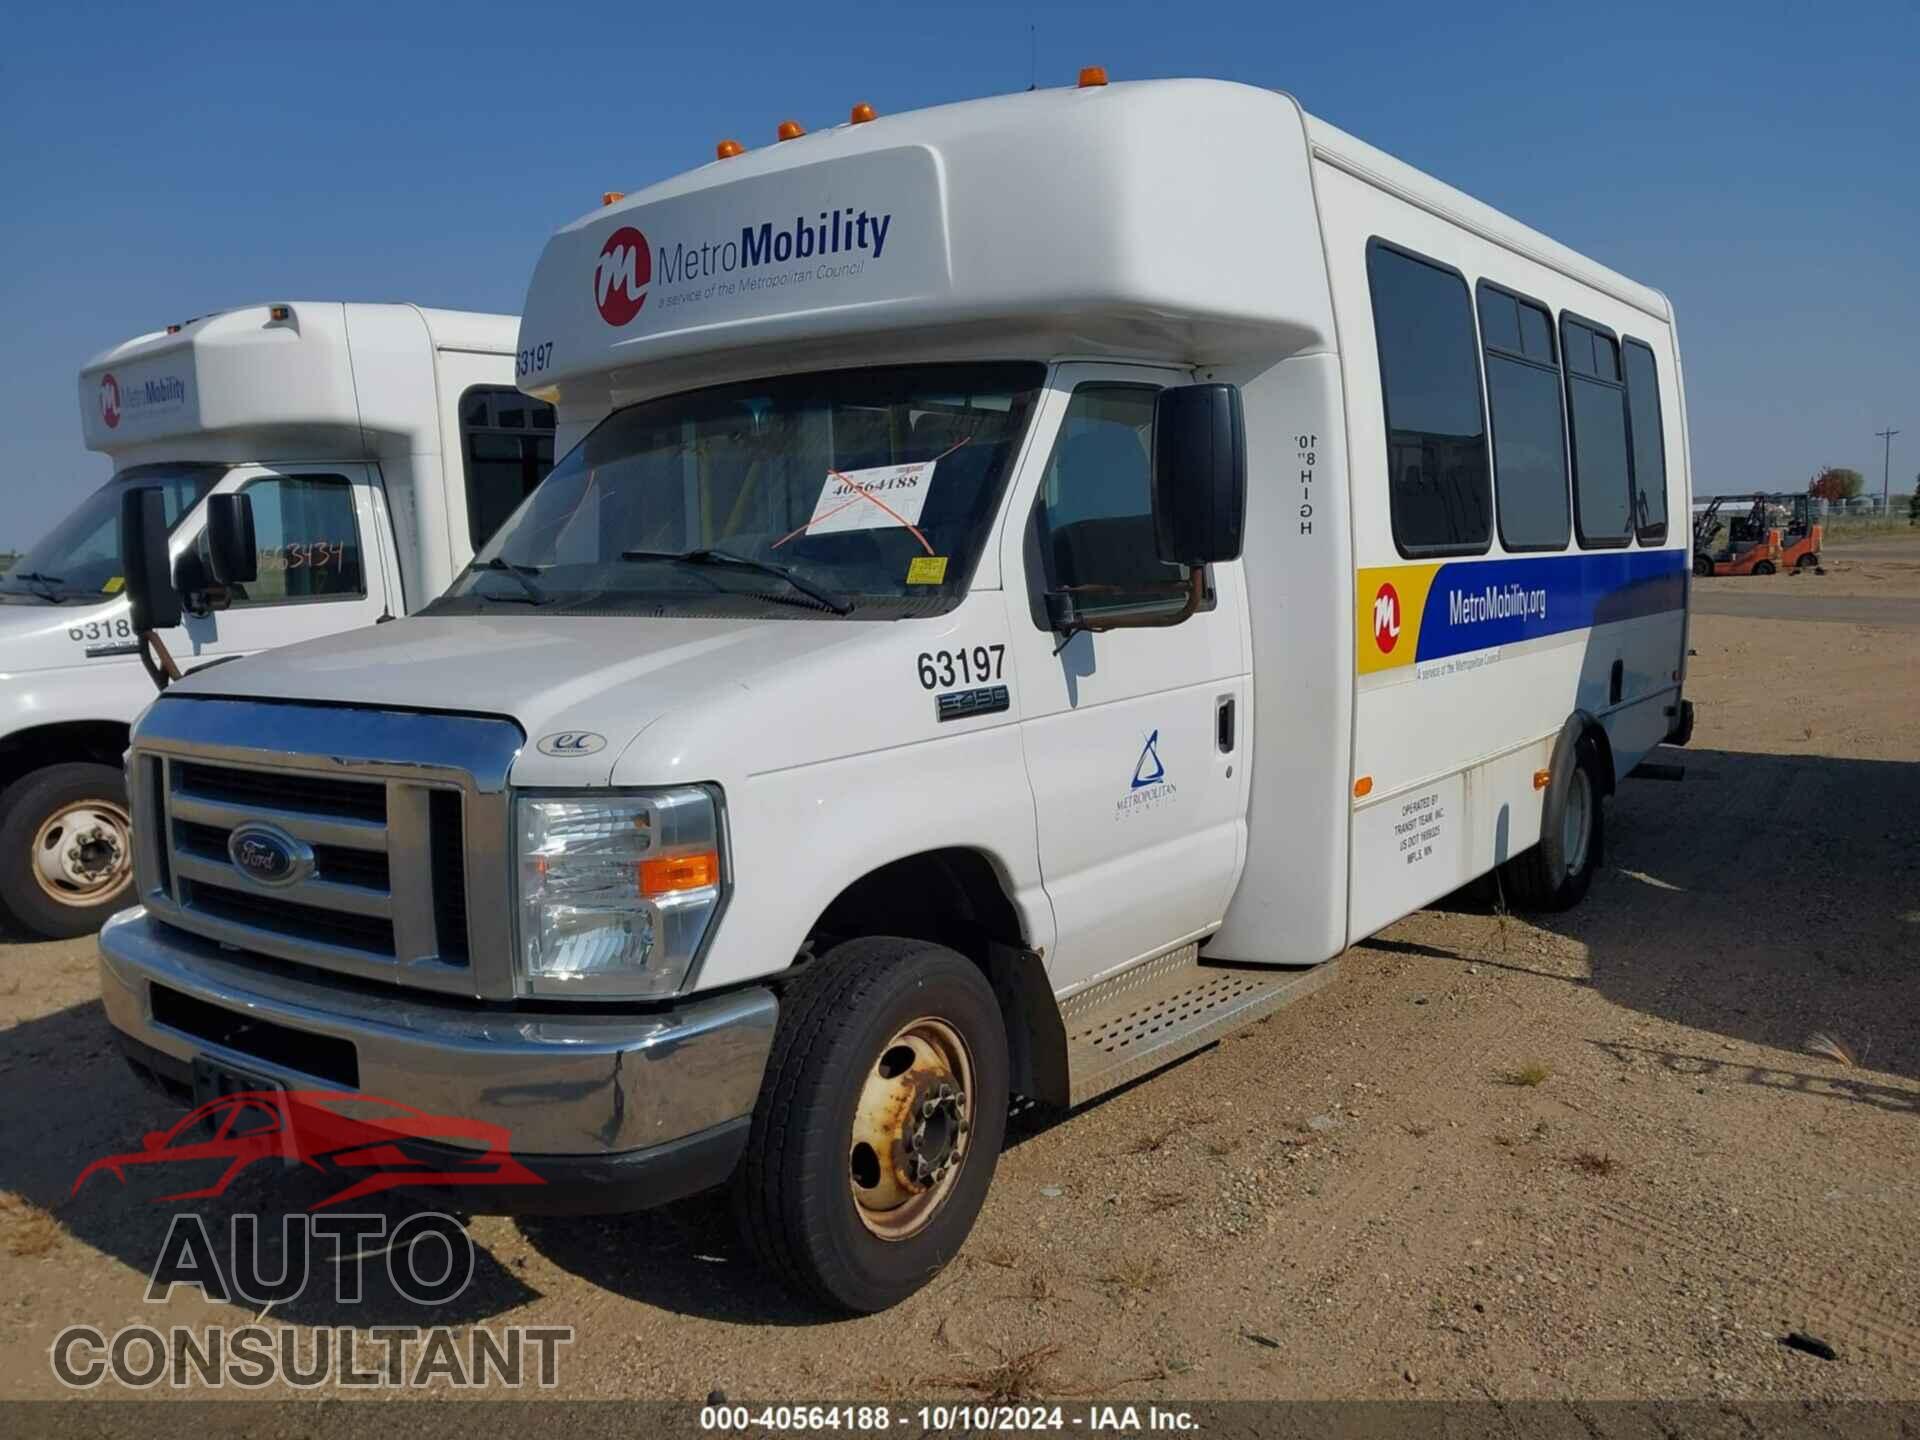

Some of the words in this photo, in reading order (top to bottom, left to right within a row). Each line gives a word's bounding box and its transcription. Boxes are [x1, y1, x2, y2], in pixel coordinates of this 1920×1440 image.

[657, 208, 892, 286] MetroMobility
[667, 290, 702, 307] service
[703, 284, 717, 299] of
[718, 280, 736, 296] the
[738, 269, 813, 293] Metropolitan
[816, 260, 865, 280] Council
[1449, 583, 1546, 627] MetroMobility.org
[68, 618, 137, 641] 6318
[917, 643, 1005, 690] 63197
[1401, 796, 1430, 816] OPERATED
[241, 840, 275, 873] Ford
